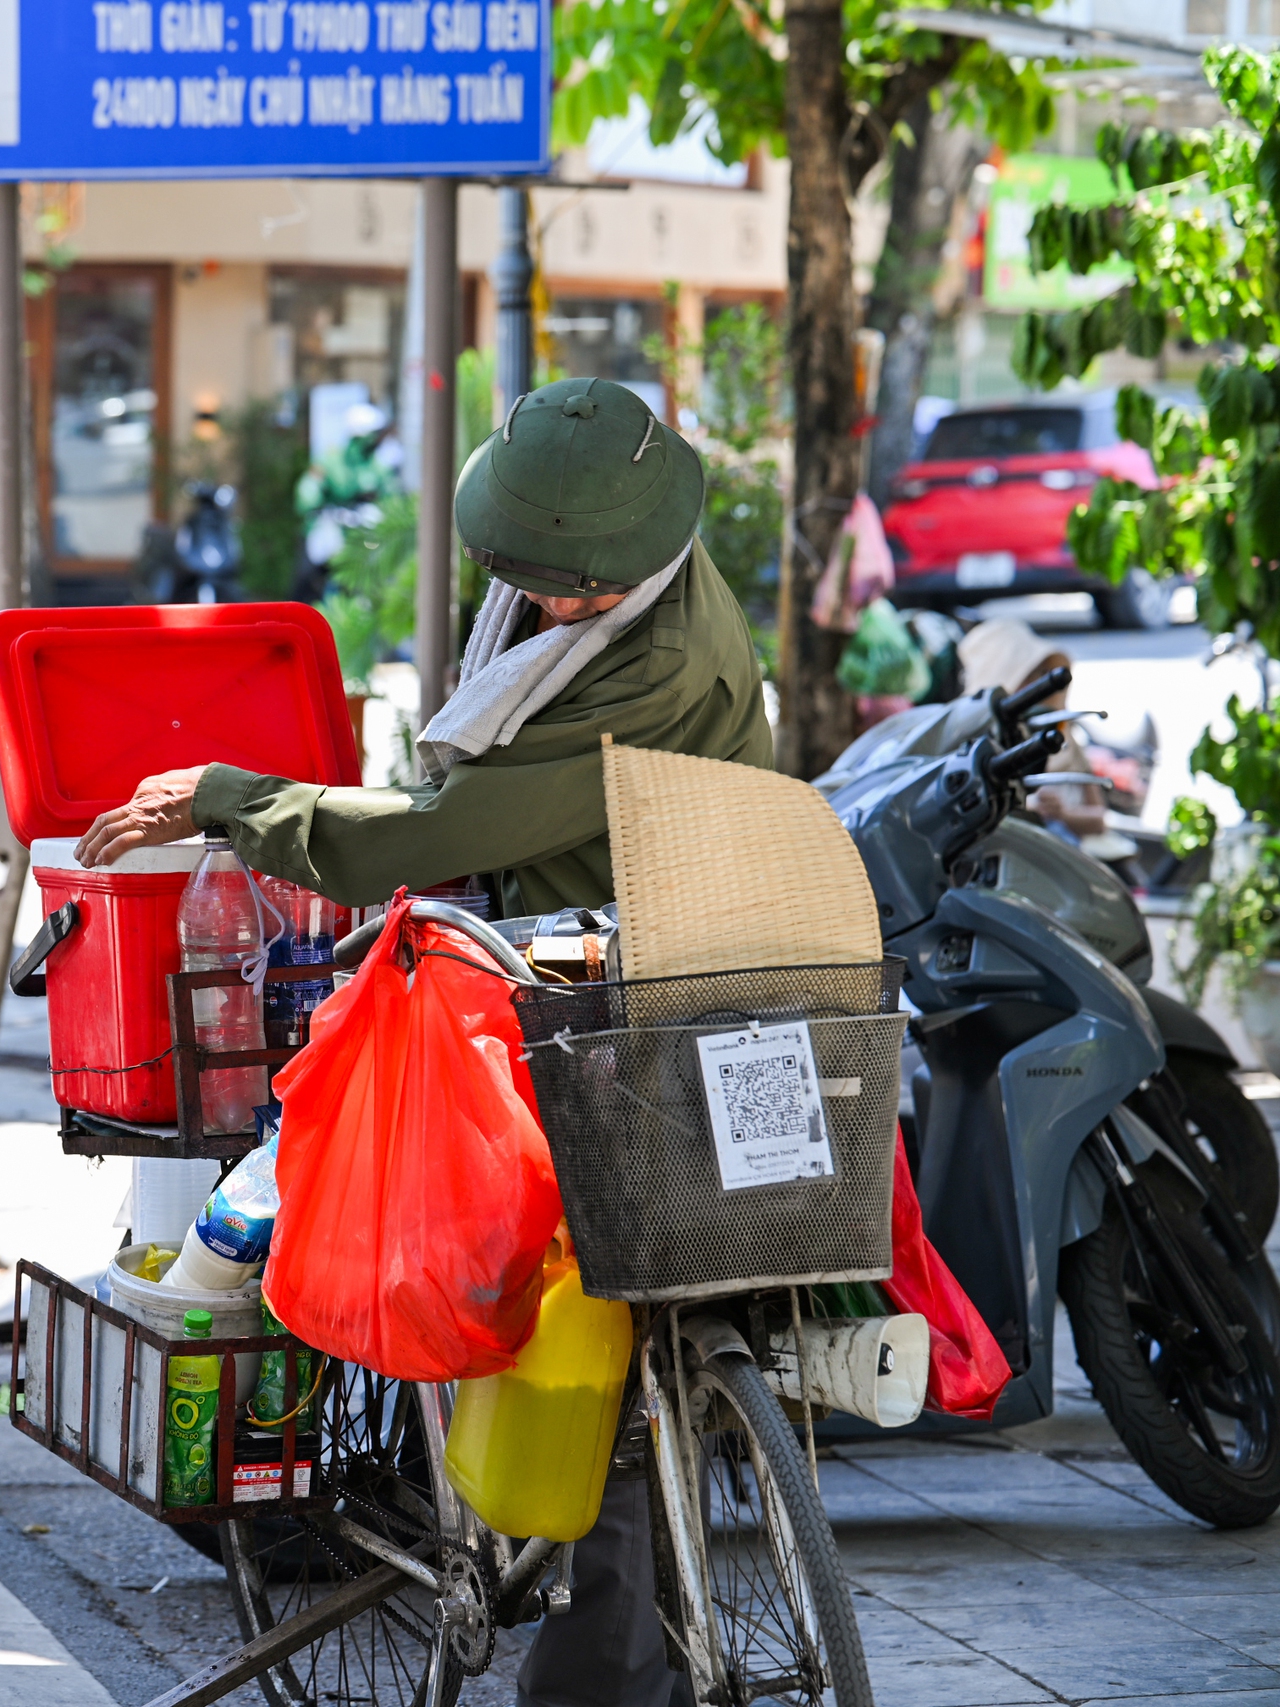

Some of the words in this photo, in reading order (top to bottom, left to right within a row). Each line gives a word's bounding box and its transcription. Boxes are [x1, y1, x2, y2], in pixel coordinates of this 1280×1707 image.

[289, 2, 369, 53] 19H00
[92, 76, 176, 129] 24H00
[178, 65, 246, 128] NGÀY
[249, 57, 304, 127] CHỦ
[308, 65, 375, 135] NHẬT
[380, 64, 451, 126] HÀNG
[1026, 1067, 1084, 1078] HONDA
[180, 1371, 198, 1379] LEMON
[169, 1429, 189, 1440] KHÔNG
